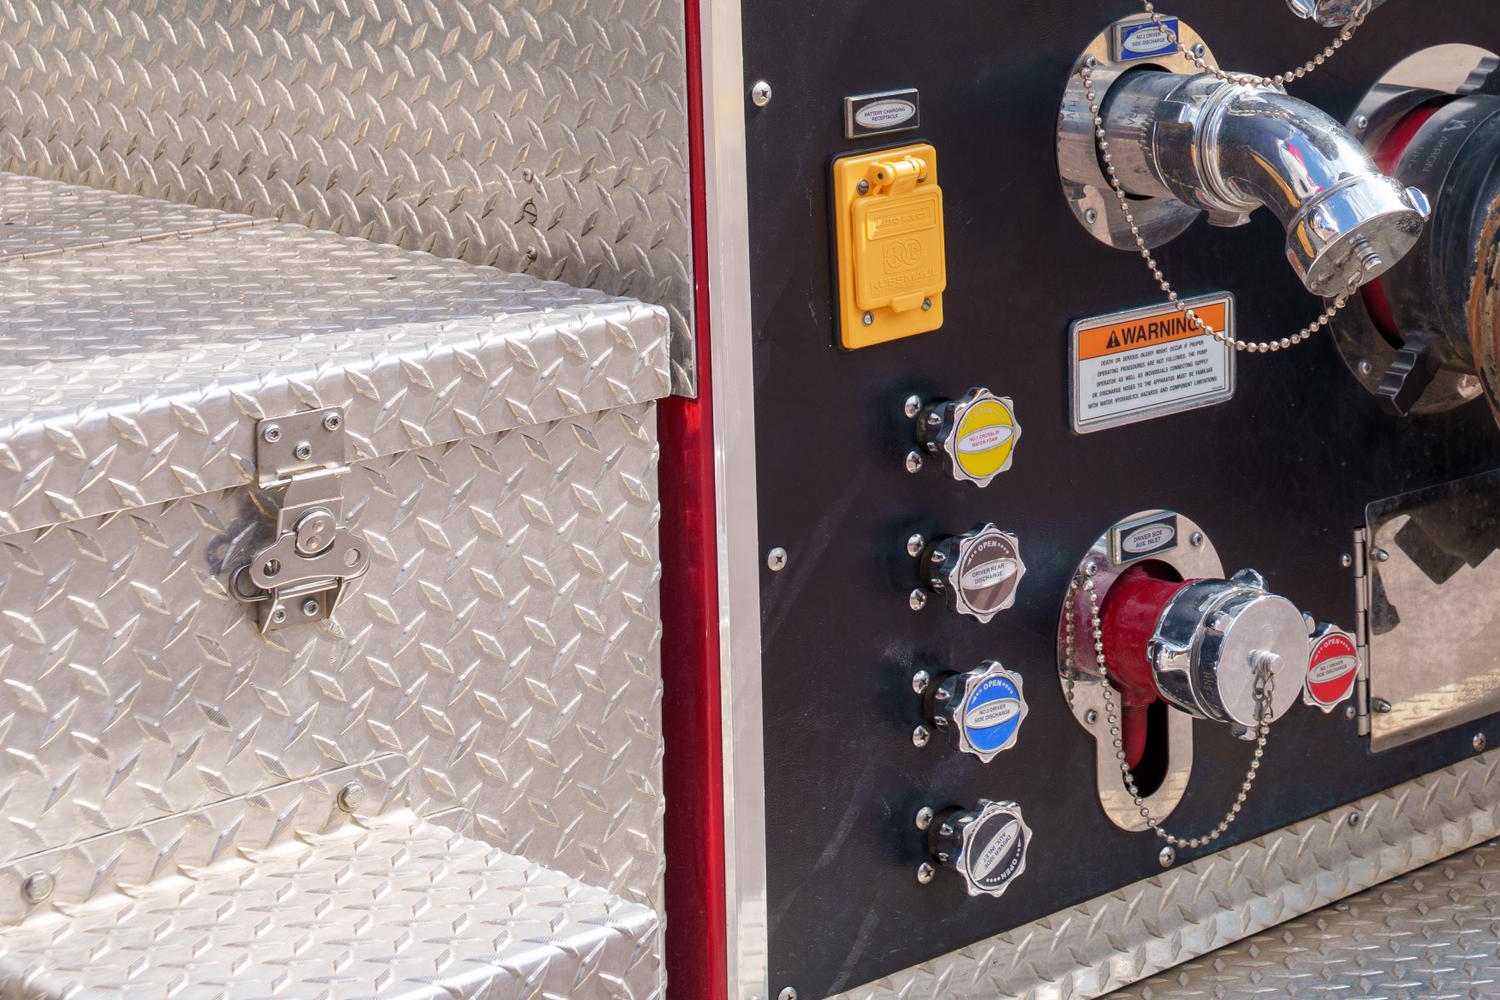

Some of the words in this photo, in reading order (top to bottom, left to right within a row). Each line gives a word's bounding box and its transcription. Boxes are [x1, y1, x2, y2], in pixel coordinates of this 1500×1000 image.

[1142, 38, 1165, 46] DISCHARGE
[1096, 378, 1116, 387] OPERATOR
[1145, 367, 1168, 376] INDIVIDUALS
[1170, 361, 1193, 371] CONNECTING
[1097, 368, 1118, 377] OPERATING
[1120, 362, 1145, 372] PROCEDURES
[1099, 387, 1121, 397] DISCHARGE
[1154, 376, 1175, 384] APPARATUS
[1115, 393, 1139, 403] HYDRAULICS
[1170, 381, 1192, 391] COMPONENT
[1194, 376, 1216, 385] LIMITATIONS
[1134, 532, 1151, 542] DRIVER
[1148, 537, 1161, 545] INLET
[978, 540, 997, 552] OPEN
[972, 567, 990, 578] DRIVER
[991, 563, 1004, 573] REAR
[974, 572, 1003, 584] DISCHARGE
[1324, 638, 1339, 648] OPEN
[1325, 664, 1347, 676] DISCHARGE
[983, 680, 1001, 690] OPEN
[985, 709, 1010, 720] DISCHARGE
[994, 835, 1012, 857] DRIVER
[983, 845, 996, 863] INLET
[984, 856, 994, 870] SIDE
[1001, 858, 1018, 880] OPEN
